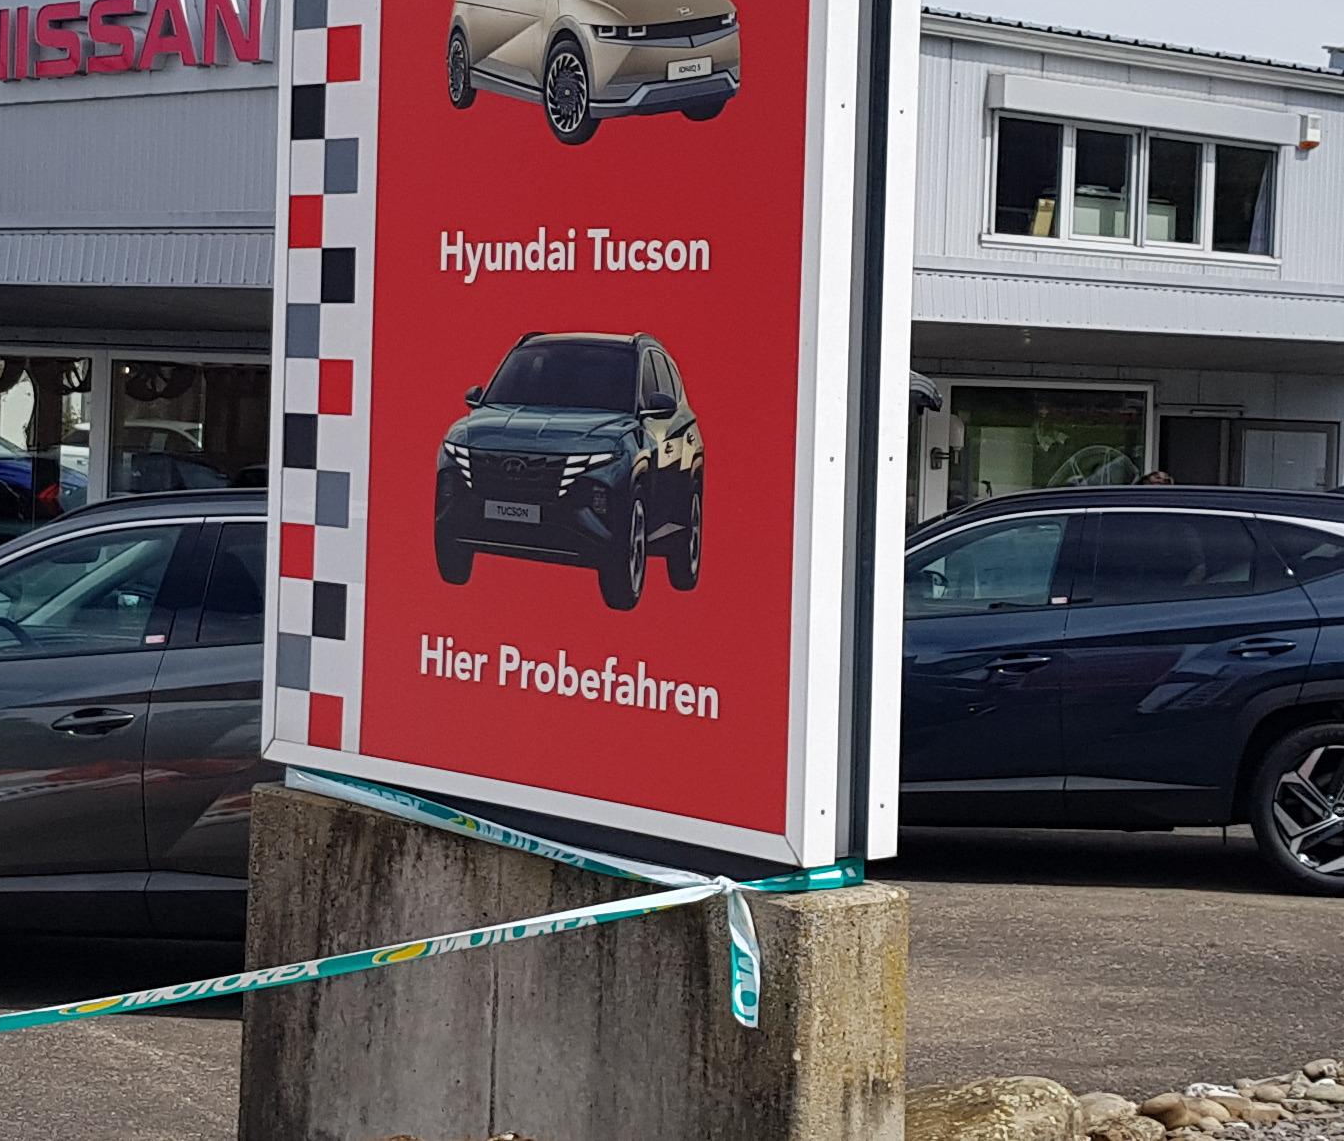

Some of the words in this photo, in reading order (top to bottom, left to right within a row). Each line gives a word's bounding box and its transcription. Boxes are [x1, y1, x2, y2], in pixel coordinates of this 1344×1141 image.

[439, 226, 576, 284] Hyundai
[587, 228, 711, 271] Tucson
[496, 505, 529, 518] TUCSON
[419, 634, 488, 682] Hier
[499, 644, 720, 719] Probefahren
[122, 958, 323, 1007] MOTOREX
